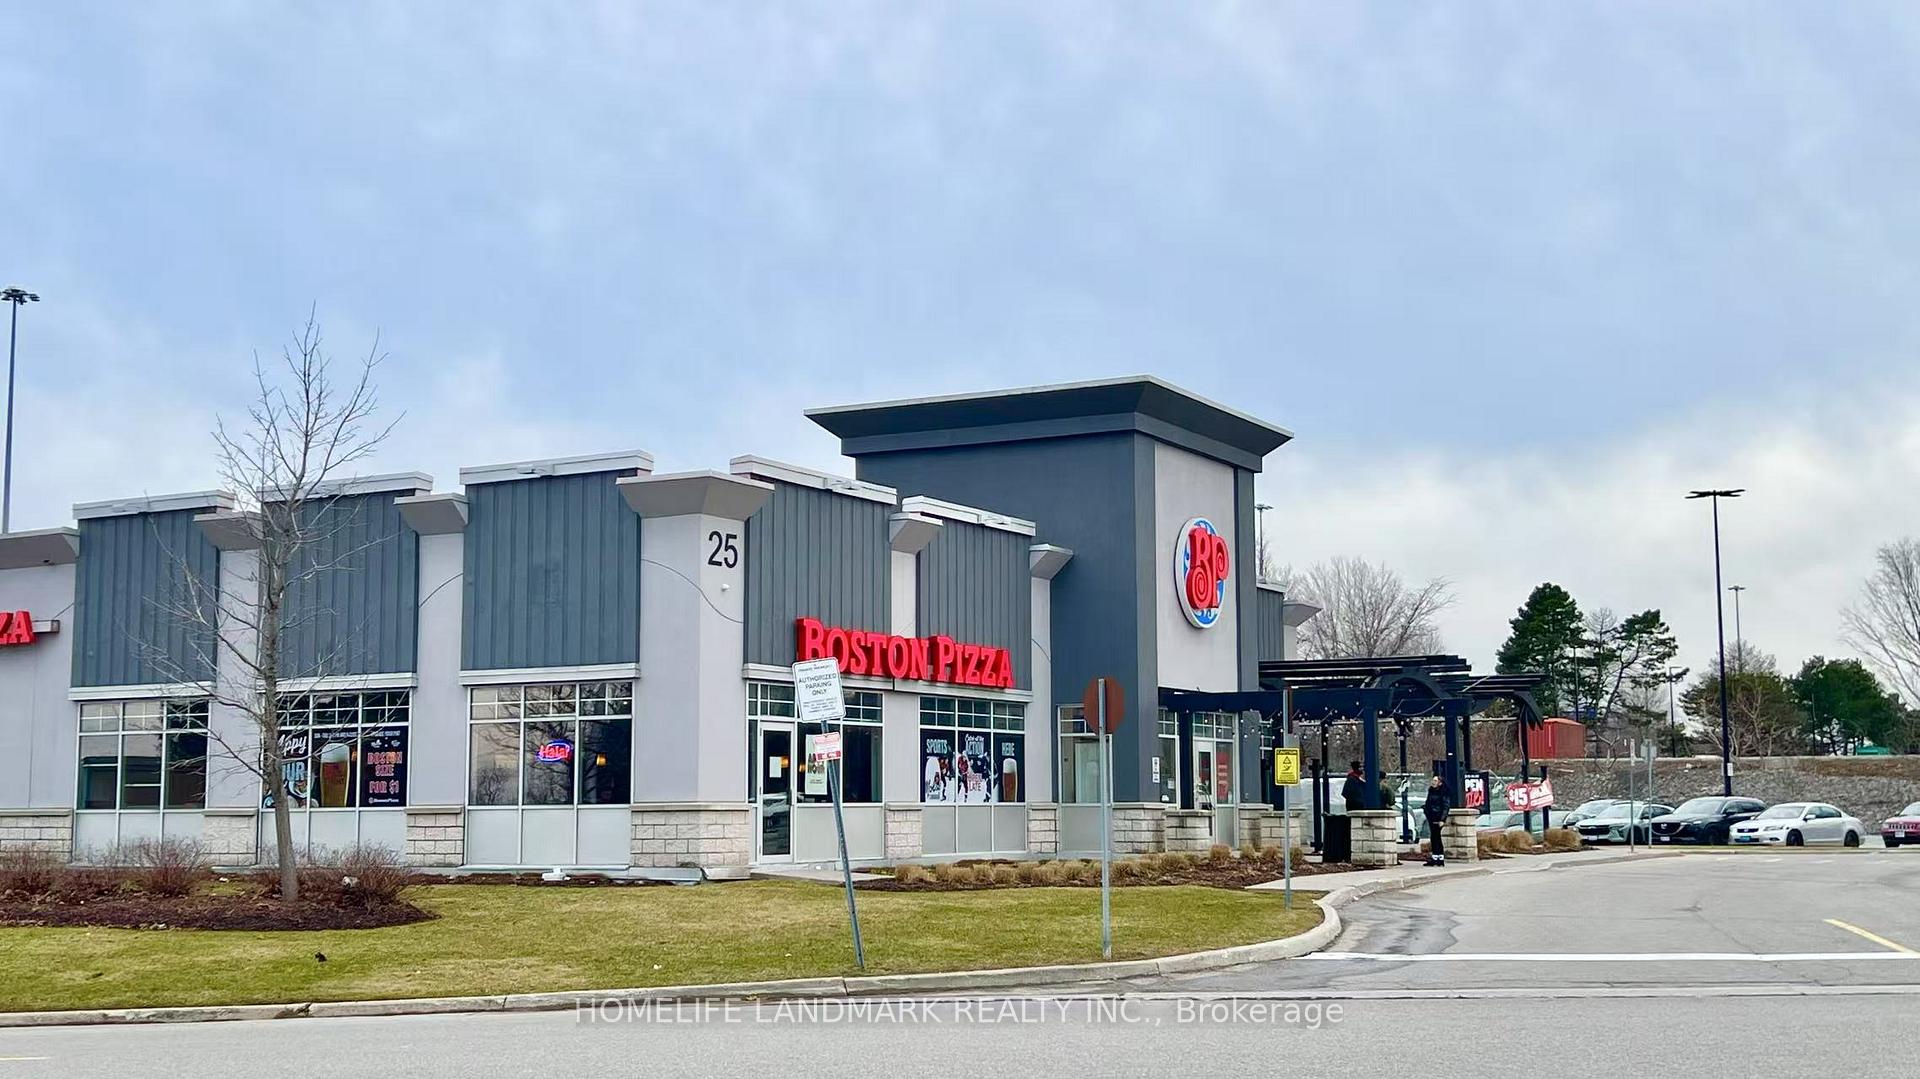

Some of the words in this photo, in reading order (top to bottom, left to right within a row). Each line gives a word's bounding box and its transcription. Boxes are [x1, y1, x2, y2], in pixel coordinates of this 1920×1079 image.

[708, 530, 738, 569] 25
[796, 617, 931, 681] BOSTON
[935, 635, 1016, 689] PIZZA
[798, 672, 837, 683] AUTHORIZED
[805, 680, 832, 689] PARKING
[811, 688, 827, 696] ONLY
[926, 739, 948, 754] SPORTS
[1508, 788, 1528, 806] $15
